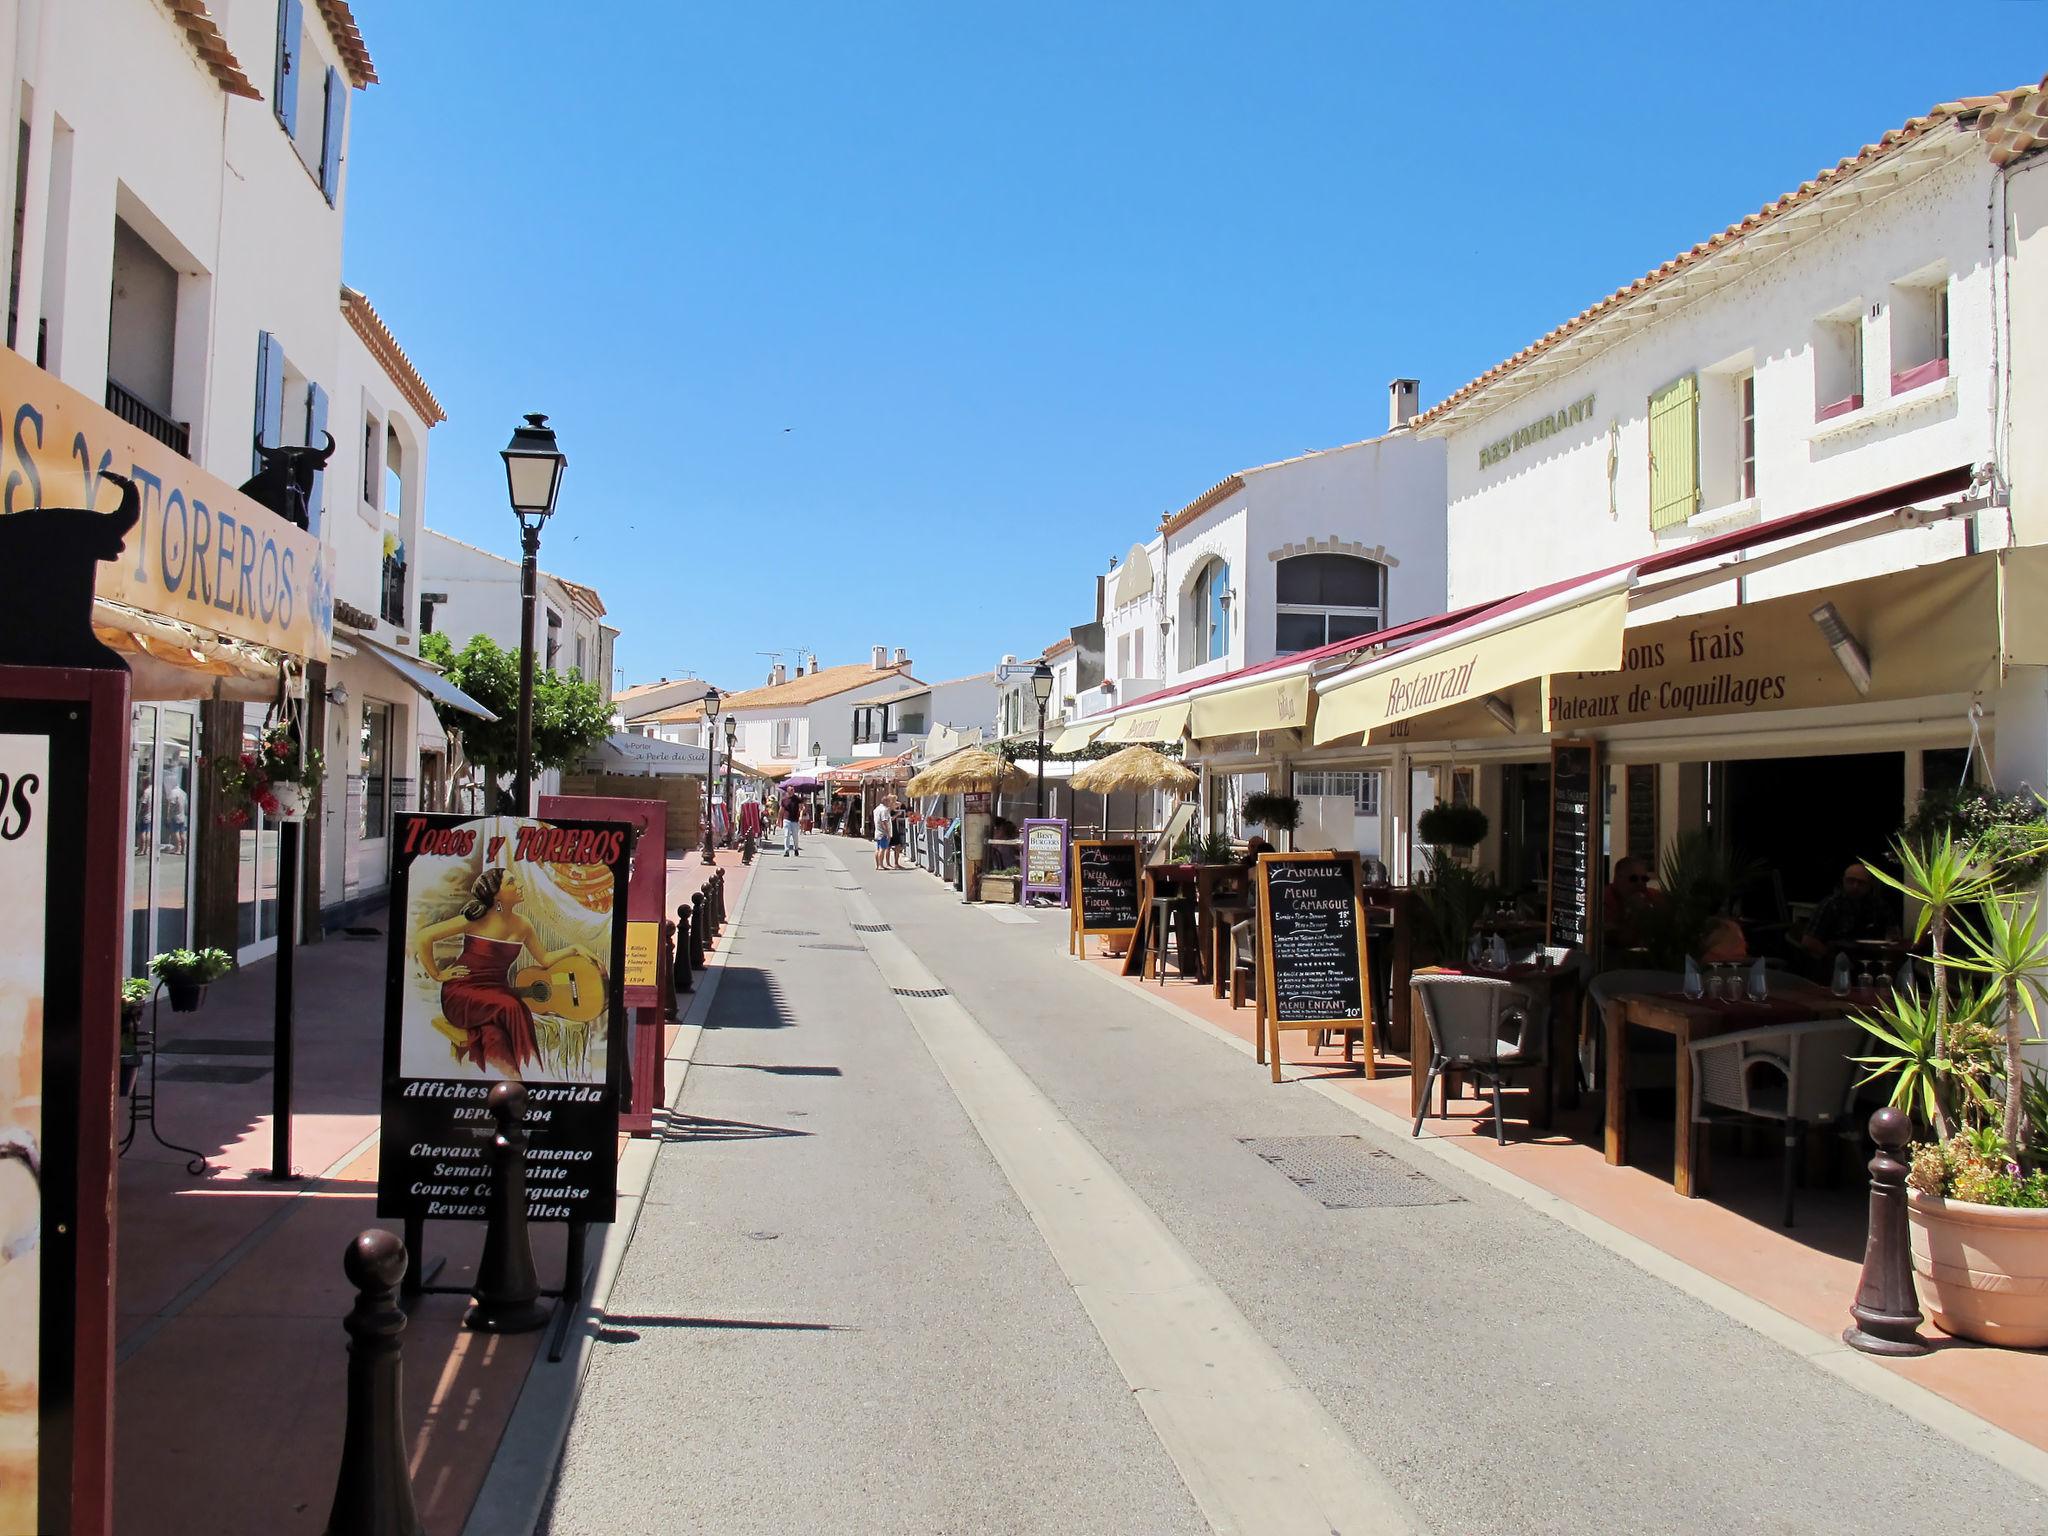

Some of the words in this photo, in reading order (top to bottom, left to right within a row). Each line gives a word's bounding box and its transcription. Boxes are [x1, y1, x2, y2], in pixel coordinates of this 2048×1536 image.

[1479, 391, 1597, 471] RESTAURANT
[131, 463, 295, 631] TOREROS
[1688, 624, 1745, 663] frais
[1384, 654, 1479, 718] Restaurant
[1548, 694, 1620, 722] Plateaux
[1628, 684, 1651, 713] de
[1659, 673, 1786, 712] Coquillages
[688, 752, 706, 761] Sud
[513, 826, 625, 866] TOREROS
[1284, 888, 1318, 899] MENU
[1292, 899, 1349, 911] CAMARGUE
[1279, 1000, 1305, 1010] MENU
[1308, 999, 1348, 1009] ENFANT
[403, 1081, 489, 1099] Affiches
[410, 1143, 482, 1157] Chevaux
[411, 1182, 469, 1196] Course
[428, 1201, 486, 1215] Revues
[526, 1203, 571, 1217] illets
